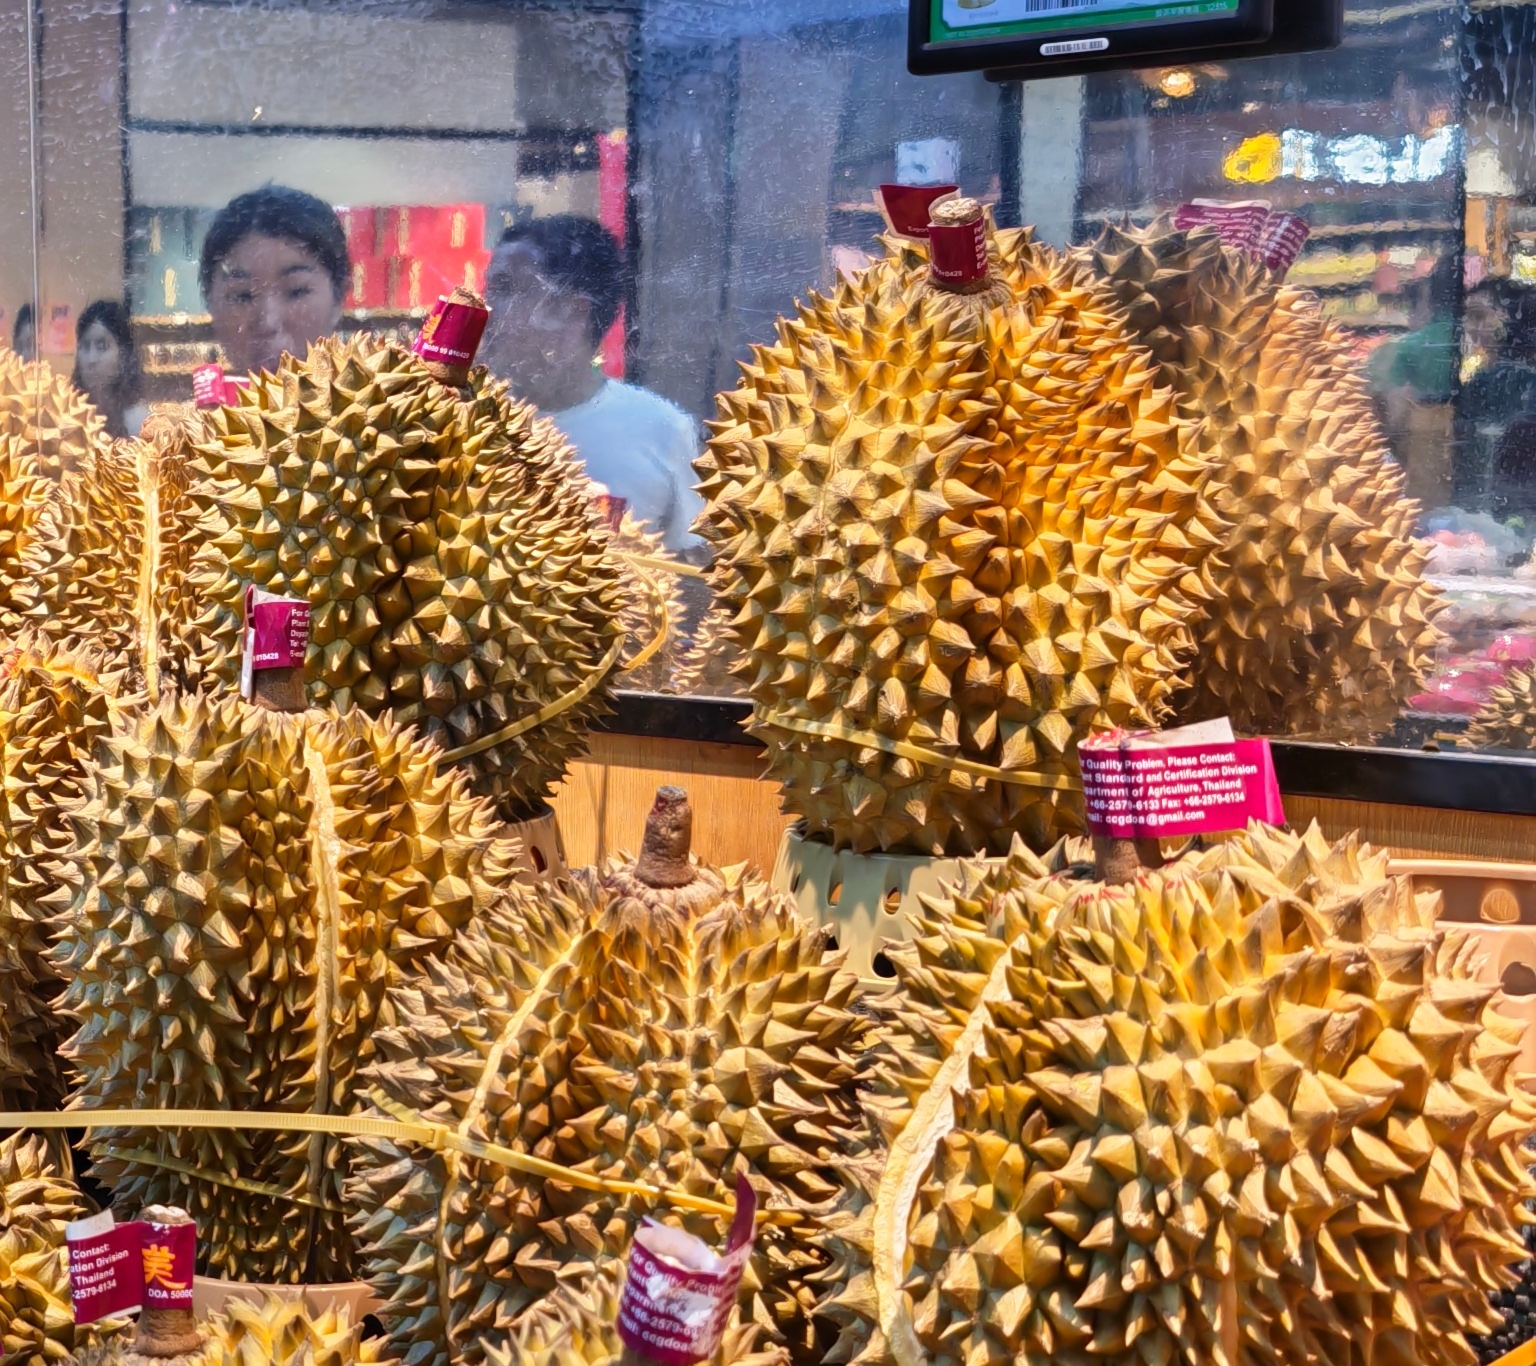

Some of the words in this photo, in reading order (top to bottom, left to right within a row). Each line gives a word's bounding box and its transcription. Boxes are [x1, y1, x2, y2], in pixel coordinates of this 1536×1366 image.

[1086, 758, 1123, 771] Quality
[1167, 754, 1198, 767] Please
[1199, 751, 1236, 764] Contact:
[1094, 771, 1143, 784] Standard
[1145, 770, 1163, 782] and
[1164, 766, 1220, 781] Certification
[1221, 764, 1257, 777] Division
[1132, 784, 1144, 797] of
[1147, 781, 1202, 798] Agriculture,
[1202, 778, 1242, 792] Thailand
[1161, 797, 1182, 809] Fax:
[72, 1243, 111, 1260] Contact:
[96, 1249, 130, 1268] Division
[75, 1267, 115, 1287] Thailand
[142, 1244, 188, 1290] 美
[148, 1288, 169, 1299] DOA
